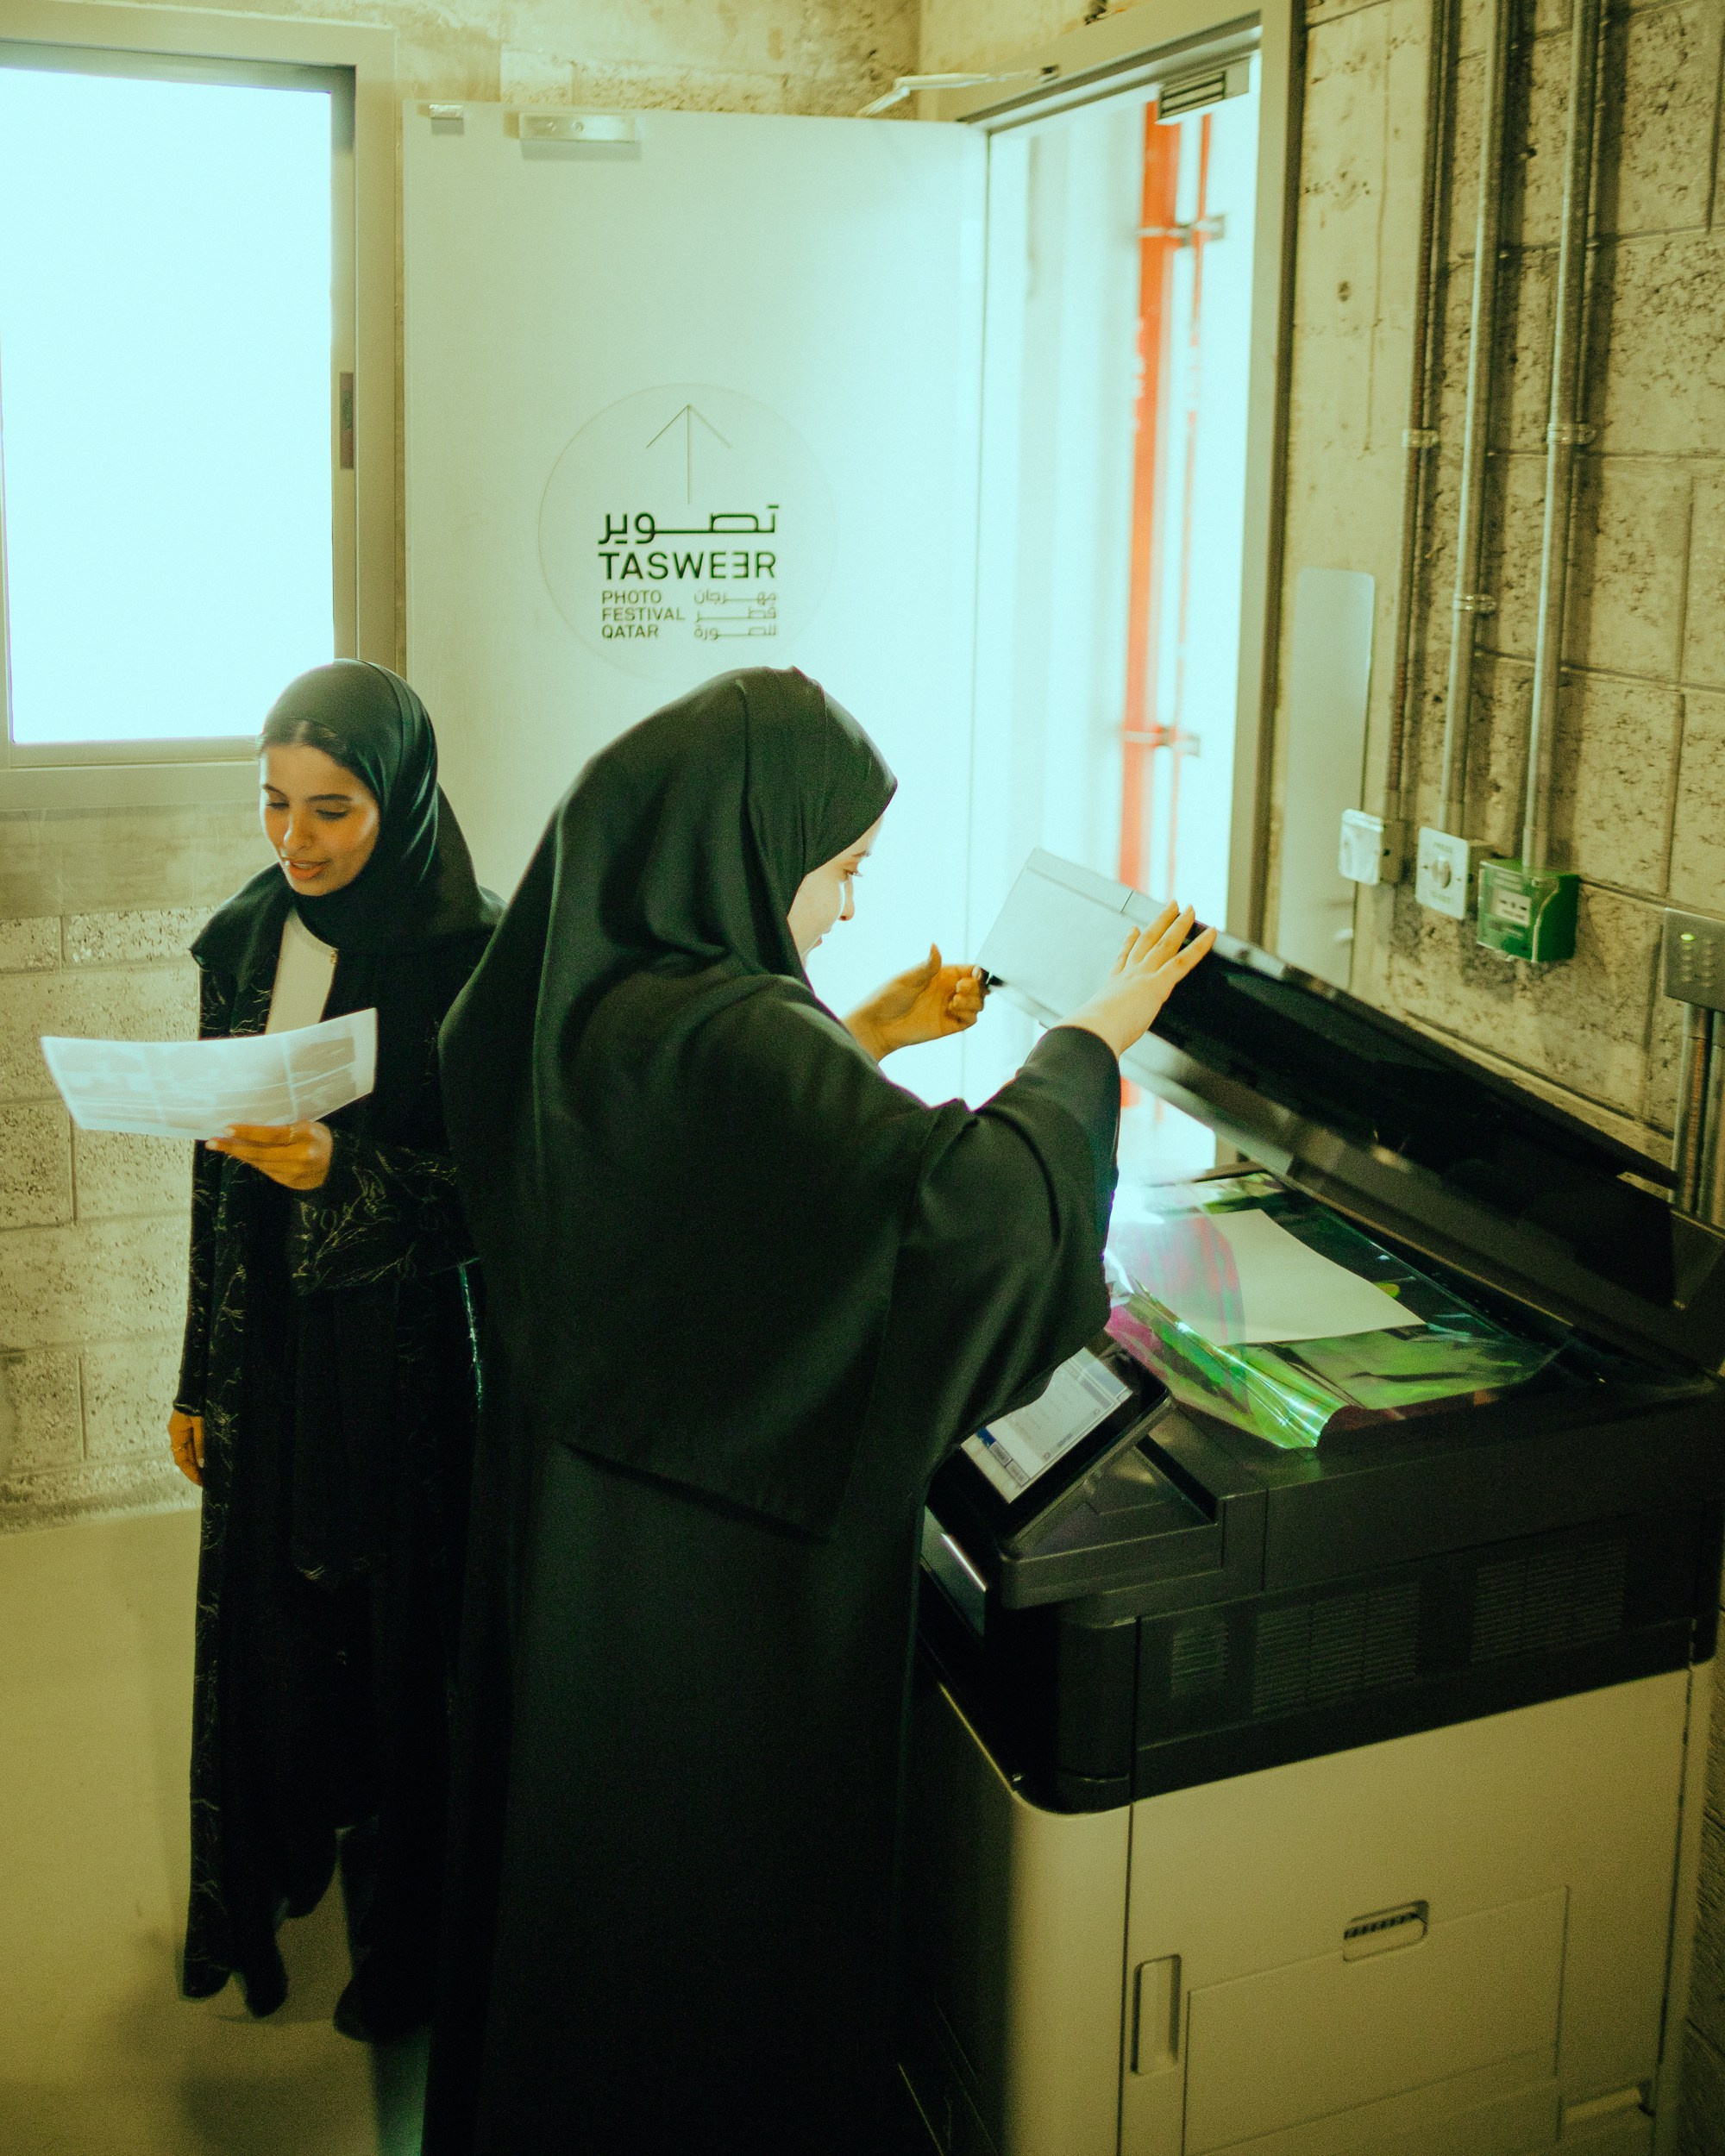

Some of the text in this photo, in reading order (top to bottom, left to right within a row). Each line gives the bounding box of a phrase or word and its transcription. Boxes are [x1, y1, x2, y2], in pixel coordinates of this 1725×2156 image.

[598, 504, 779, 544] تصوير
[602, 590, 662, 605] PHOTO
[693, 589, 776, 605] مهرجان
[602, 607, 685, 621] FESTIVAL
[602, 624, 658, 639] QATAR
